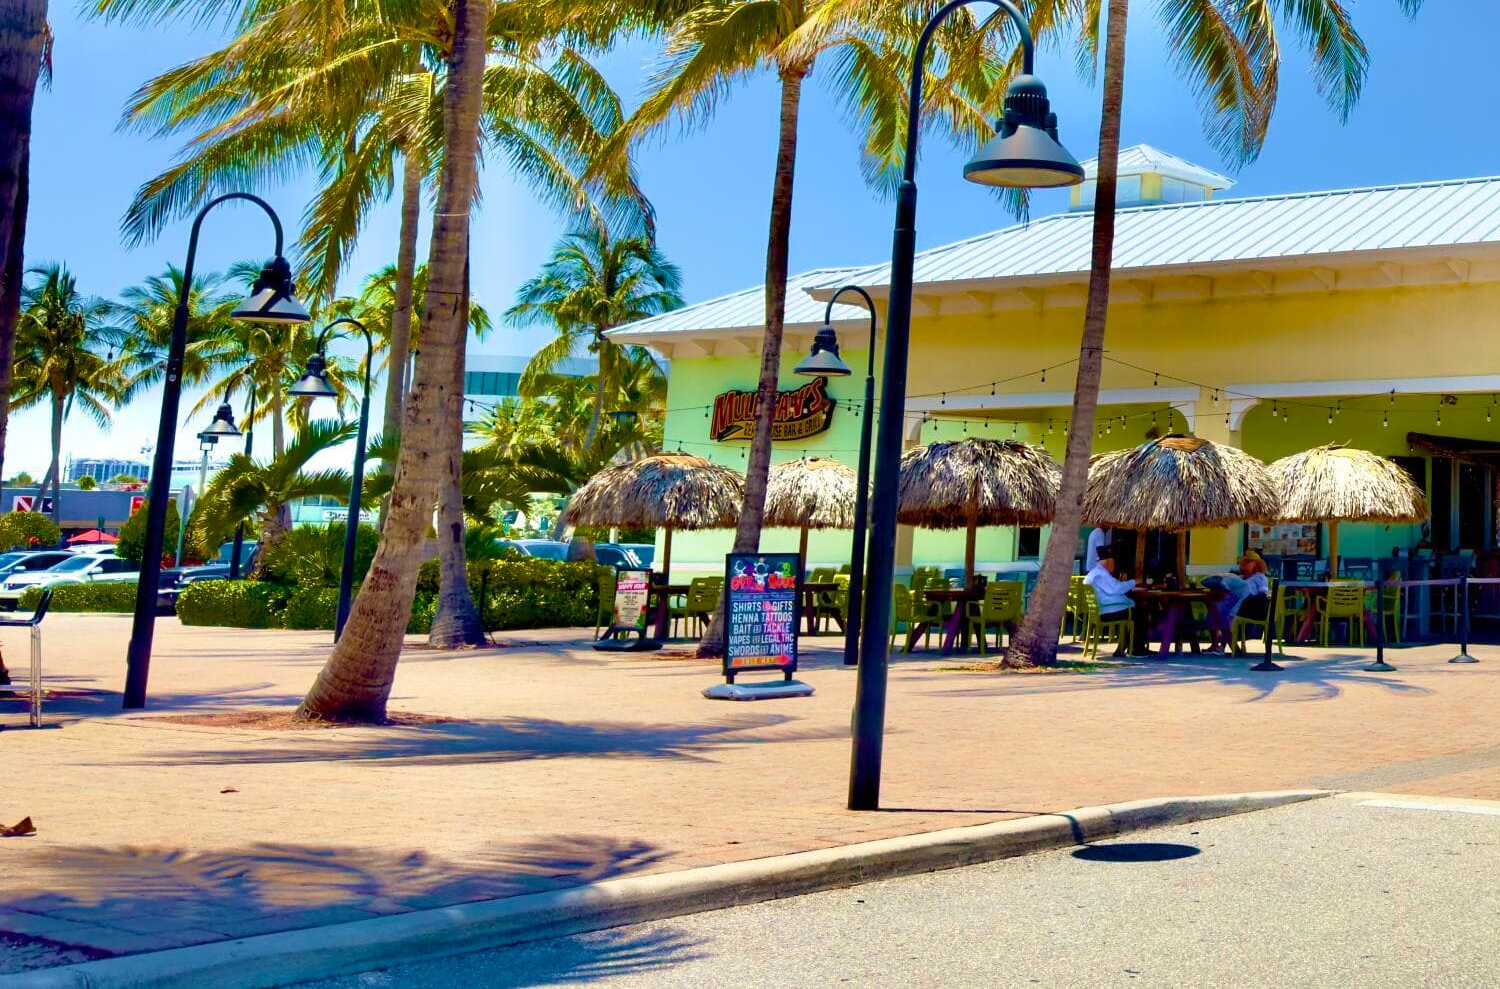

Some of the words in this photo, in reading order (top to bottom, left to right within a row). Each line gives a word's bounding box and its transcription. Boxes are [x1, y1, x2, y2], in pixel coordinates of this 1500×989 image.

[711, 378, 822, 439] MULLAN'S
[733, 601, 762, 612] SHIRTS
[772, 600, 793, 611] GIFTS
[732, 613, 759, 623] HENNA
[761, 611, 793, 622] TATTOOS
[733, 624, 751, 635] BAIT
[763, 622, 790, 633] TACKLE
[729, 635, 750, 645] VAPES
[761, 634, 780, 644] LEGAL
[781, 633, 794, 643] THC
[728, 645, 760, 656] SWORDS
[770, 643, 793, 654] ANIME
